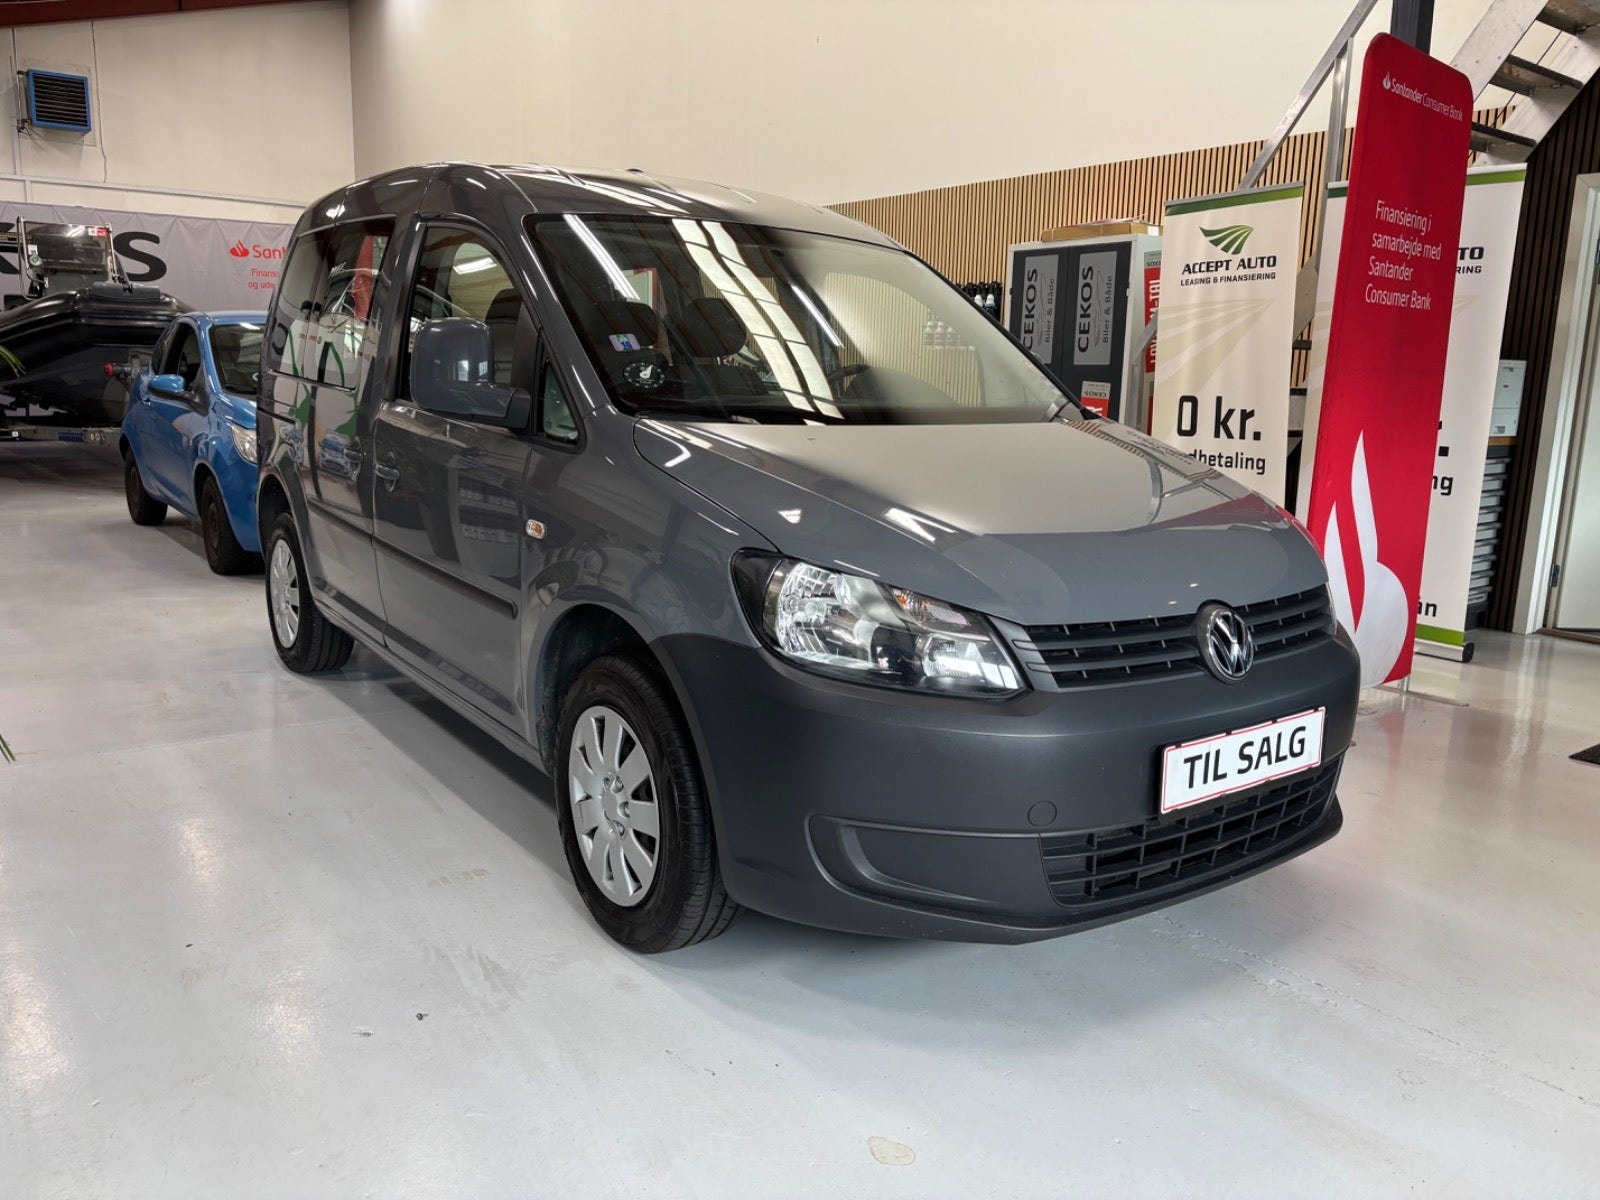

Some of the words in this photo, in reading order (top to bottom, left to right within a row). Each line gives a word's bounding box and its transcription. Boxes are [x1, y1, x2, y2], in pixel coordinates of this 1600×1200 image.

[1375, 200, 1427, 236] Finansiering
[1427, 214, 1433, 232] i
[1371, 232, 1422, 260] samarbejde
[1422, 243, 1442, 260] med
[1180, 277, 1211, 287] LEASING
[1212, 276, 1218, 284] &
[1219, 272, 1276, 283] FINANSIERING
[1181, 259, 1232, 275] ACCEPT
[1236, 255, 1277, 270] AUTO
[1368, 256, 1413, 281] Santander
[1022, 268, 1038, 352] CEKOS
[1078, 265, 1094, 353] CEKOS
[1365, 283, 1410, 307] Consumer
[1410, 290, 1432, 310] Bank
[1177, 395, 1198, 437] 0
[1214, 395, 1261, 441] kr.
[1184, 748, 1228, 790] TIL
[1237, 726, 1306, 775] SALG
